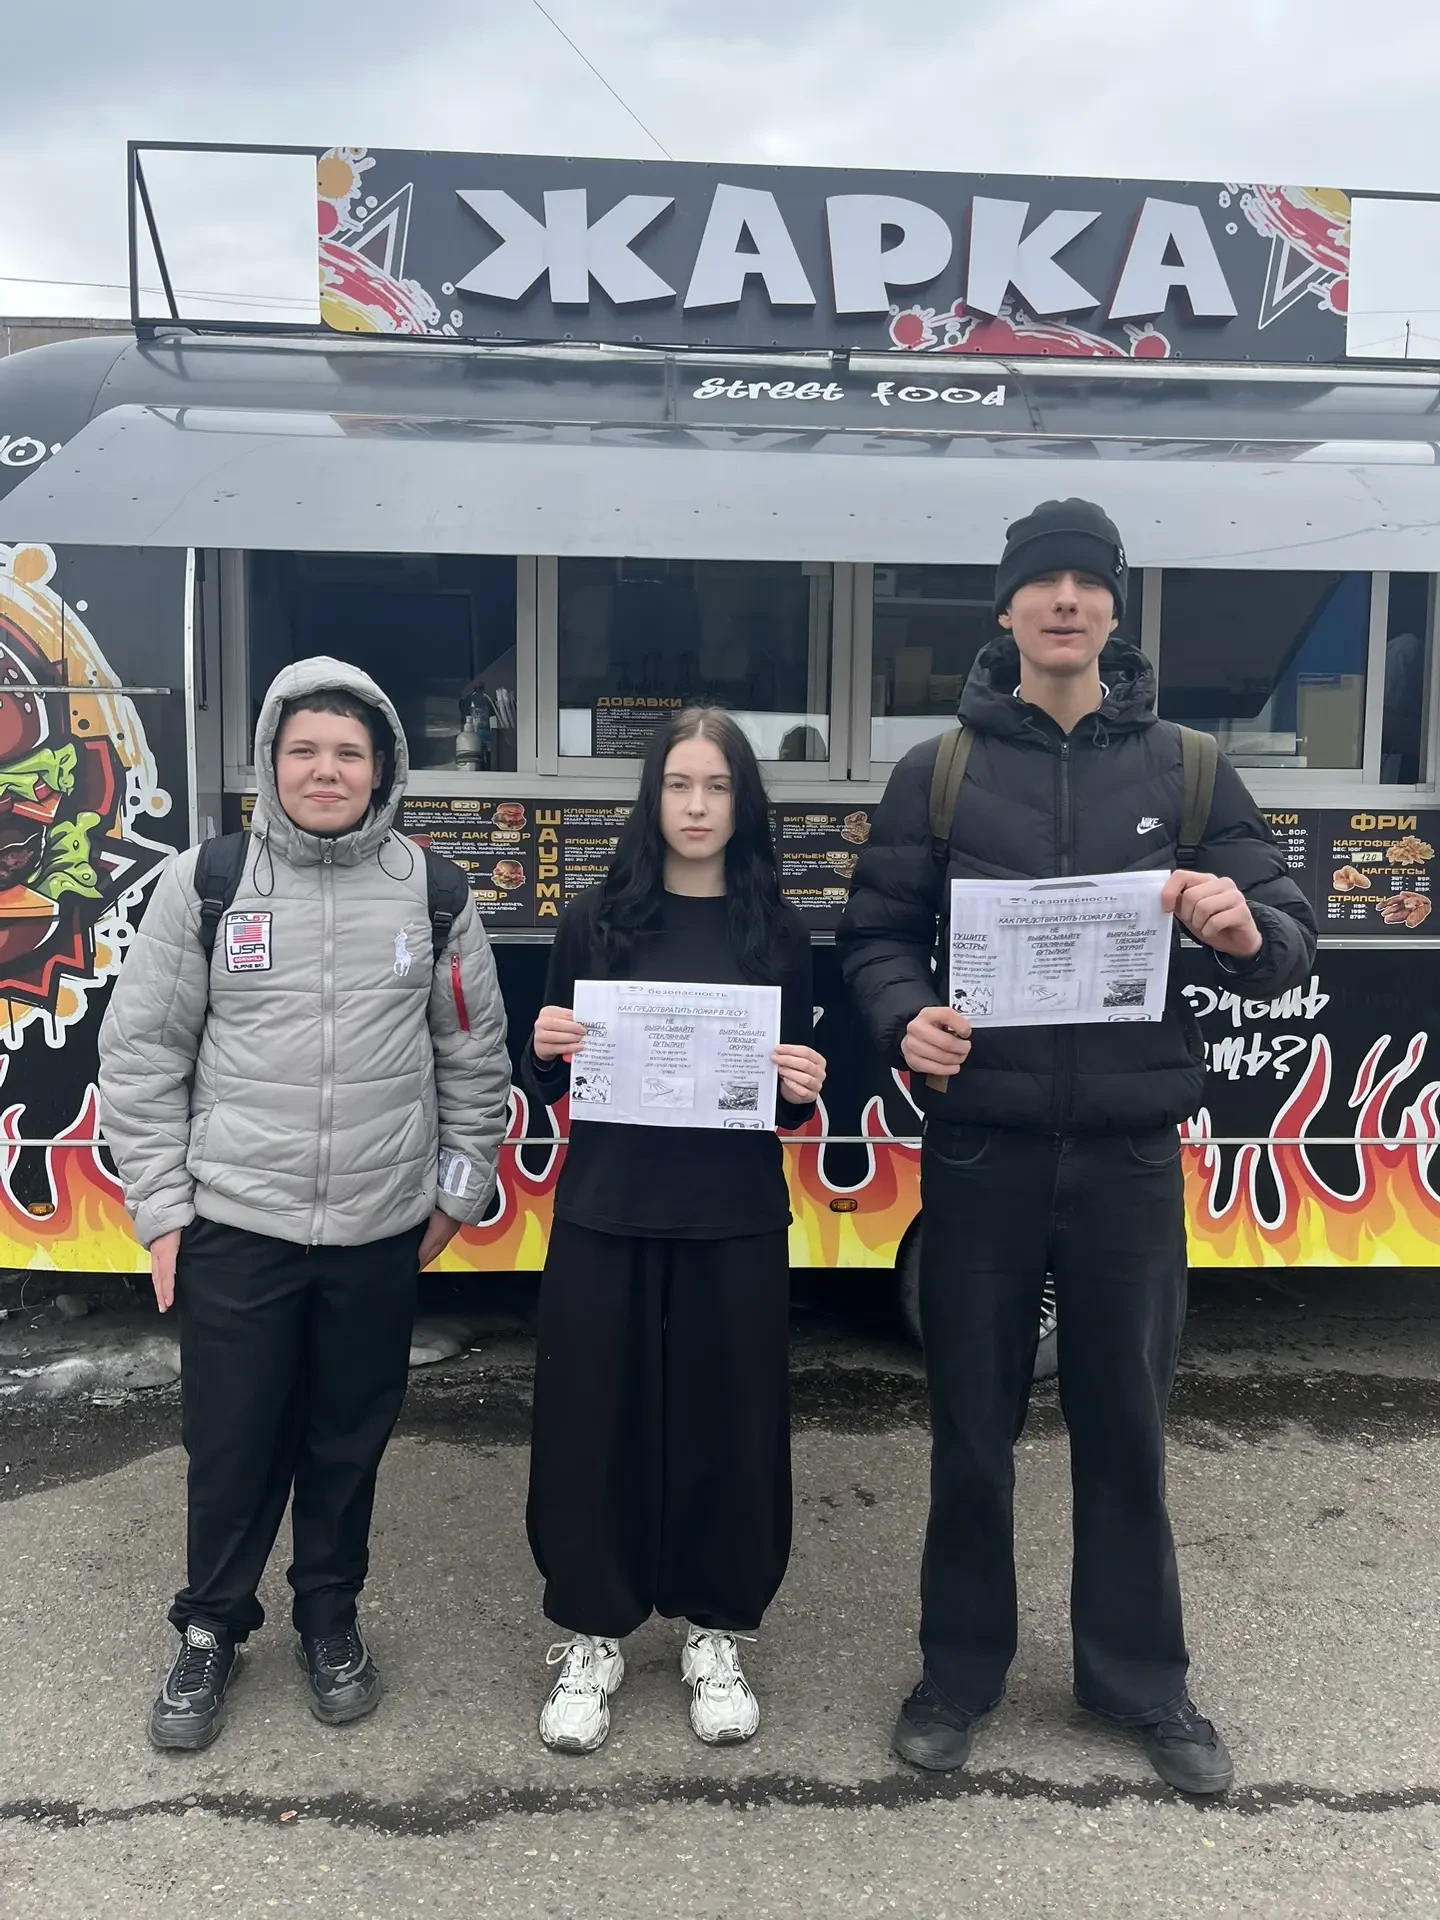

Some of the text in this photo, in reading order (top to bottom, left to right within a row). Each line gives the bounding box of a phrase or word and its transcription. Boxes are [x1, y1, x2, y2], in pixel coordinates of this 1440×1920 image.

[455, 183, 1238, 321] ЖАРКА
[692, 377, 1006, 406] Street food
[597, 696, 682, 708] ДОБАВКИ
[404, 801, 449, 809] ЖАРКА
[1140, 816, 1160, 828] NIKE
[1350, 813, 1417, 831] ФРИ
[430, 831, 458, 839] МАК
[462, 832, 489, 840] ДАК
[535, 809, 561, 917] ШАУРМА
[565, 864, 610, 872] ШВЕЙЦА
[1031, 896, 1117, 905] безопасность
[998, 916, 1015, 924] КАК
[1015, 914, 1078, 924] ПРЕДОТВРАТИТЬ
[1078, 913, 1106, 921] ПОЖАР
[953, 933, 989, 942] ТУШИТЕ
[230, 943, 266, 955] USA
[648, 988, 728, 998] безопасность
[633, 1006, 692, 1014] ПРЕДОТВРАТИТЬ
